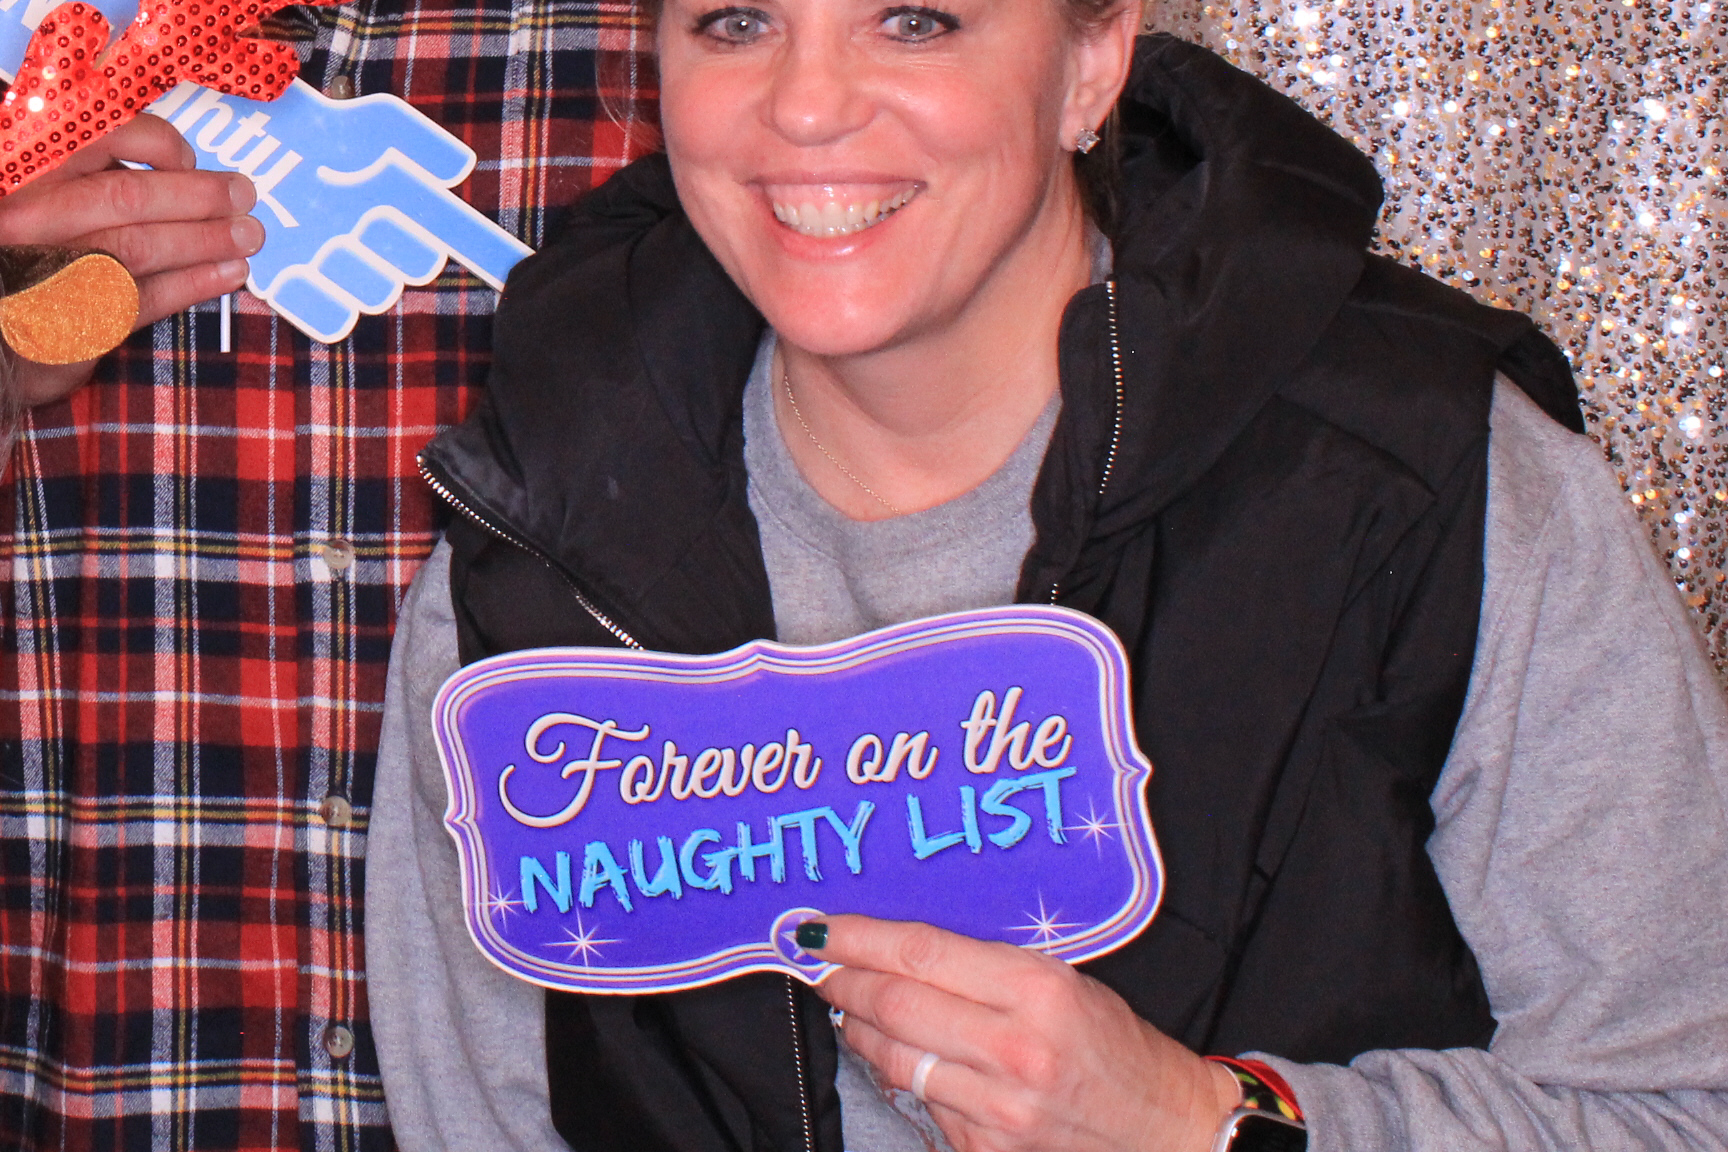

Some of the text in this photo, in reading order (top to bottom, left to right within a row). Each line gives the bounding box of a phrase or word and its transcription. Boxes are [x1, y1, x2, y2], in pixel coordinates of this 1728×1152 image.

[498, 685, 1072, 828] Forever on the
[520, 767, 1076, 914] NAUGHTY LIST
